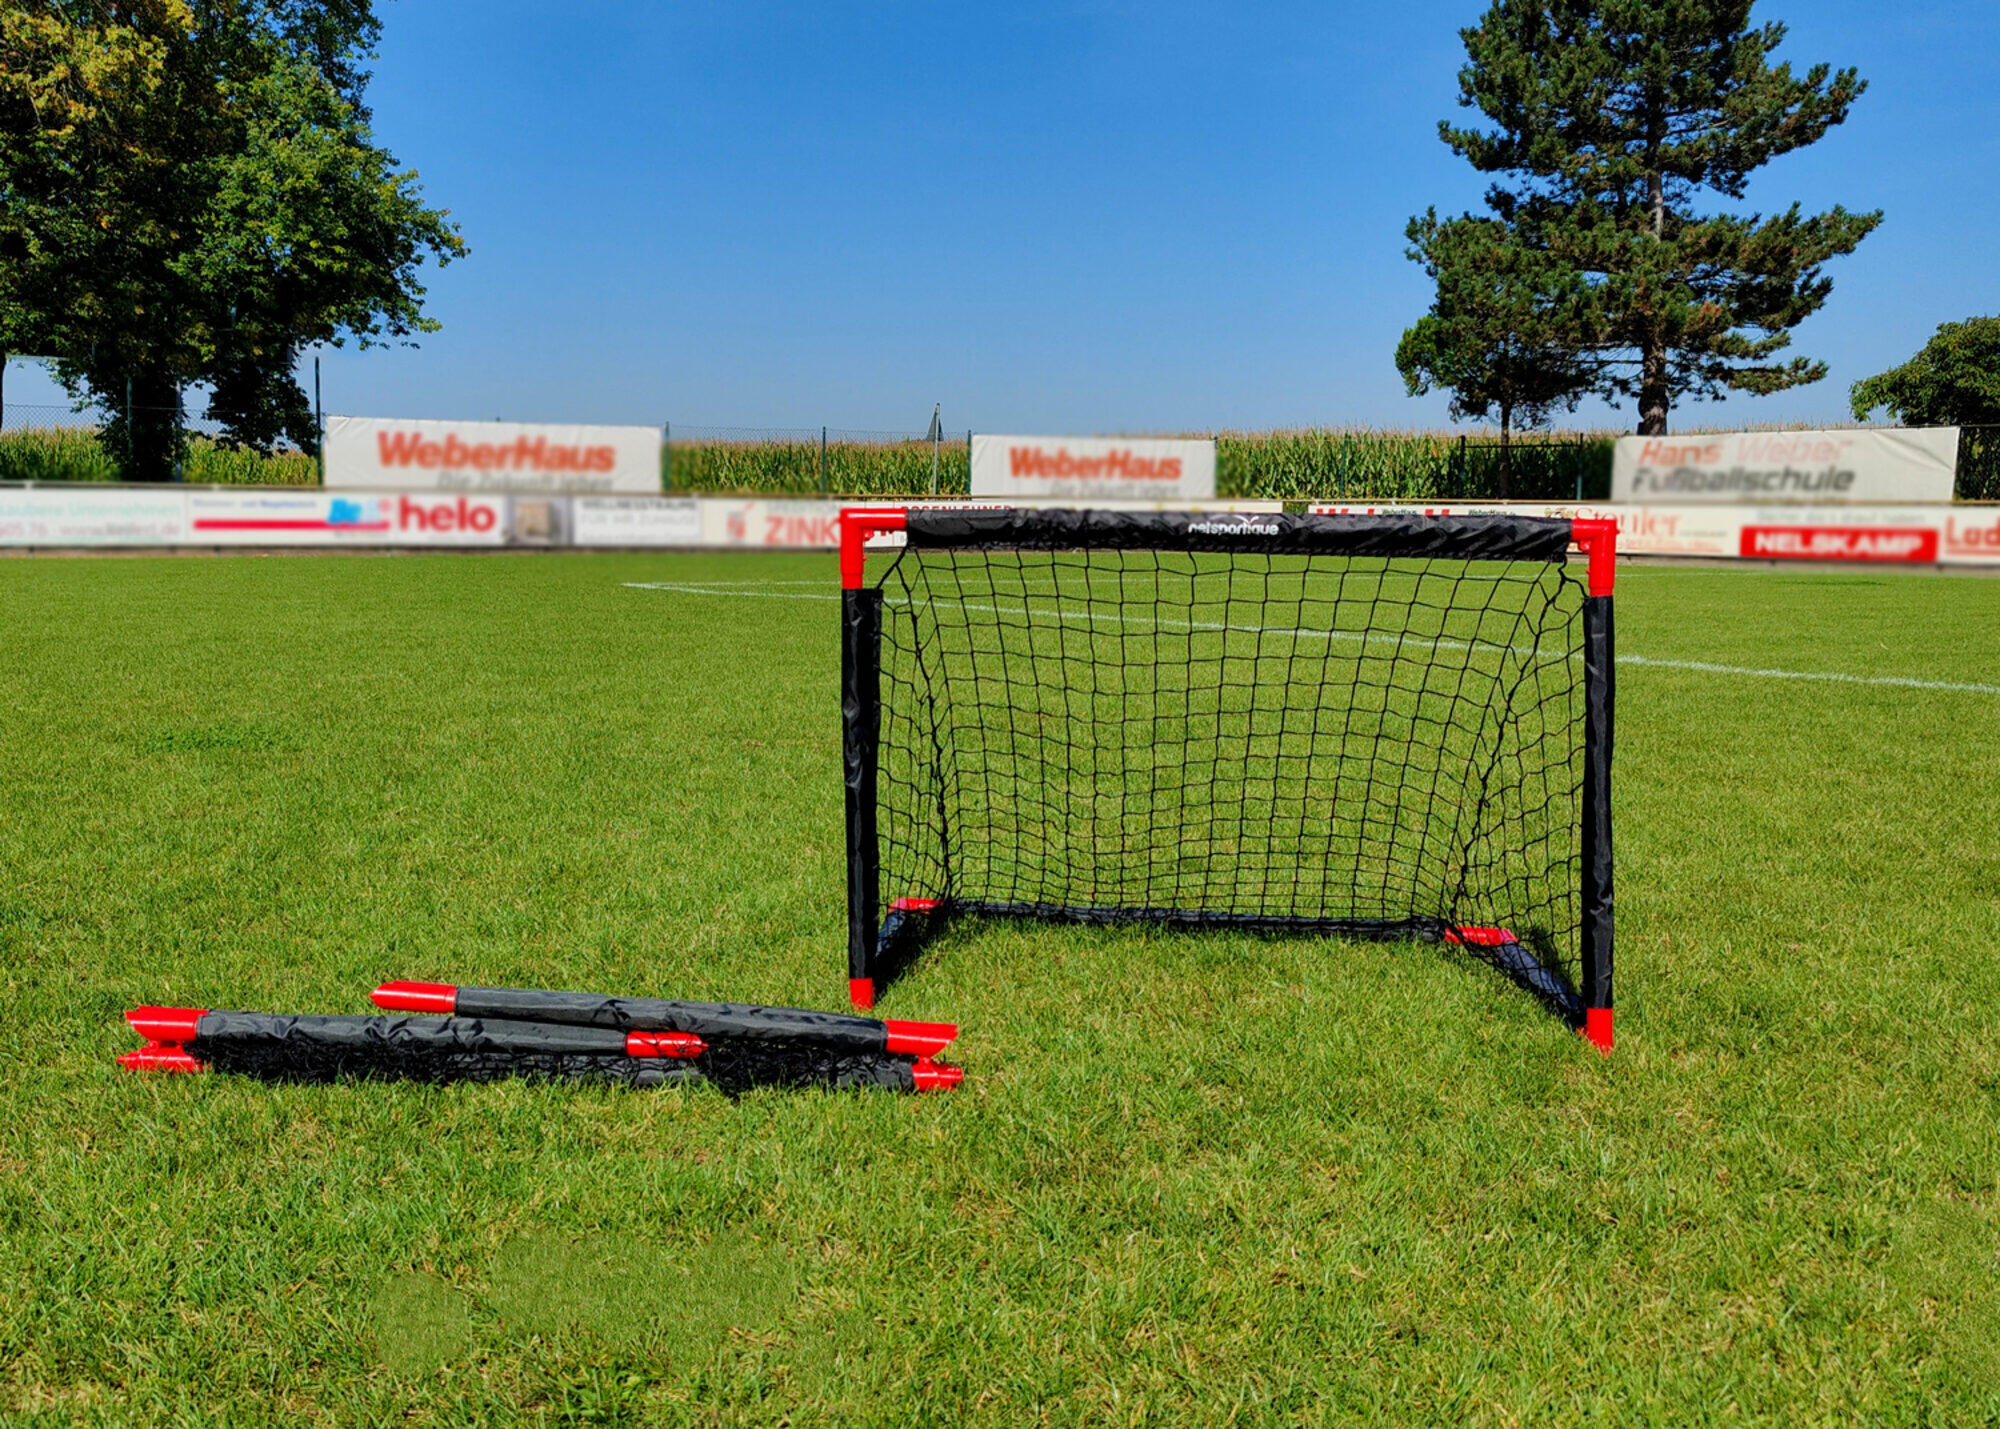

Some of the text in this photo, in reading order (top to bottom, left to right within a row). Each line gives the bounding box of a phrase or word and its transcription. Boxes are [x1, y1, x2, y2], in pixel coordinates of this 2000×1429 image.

[377, 430, 616, 473] WeberHaus
[1009, 446, 1181, 480] WeberHaus
[1637, 436, 1853, 466] Hans Weber
[400, 494, 495, 532] helo
[764, 515, 840, 545] ZINK
[1755, 531, 1923, 555] NELSKAMP
